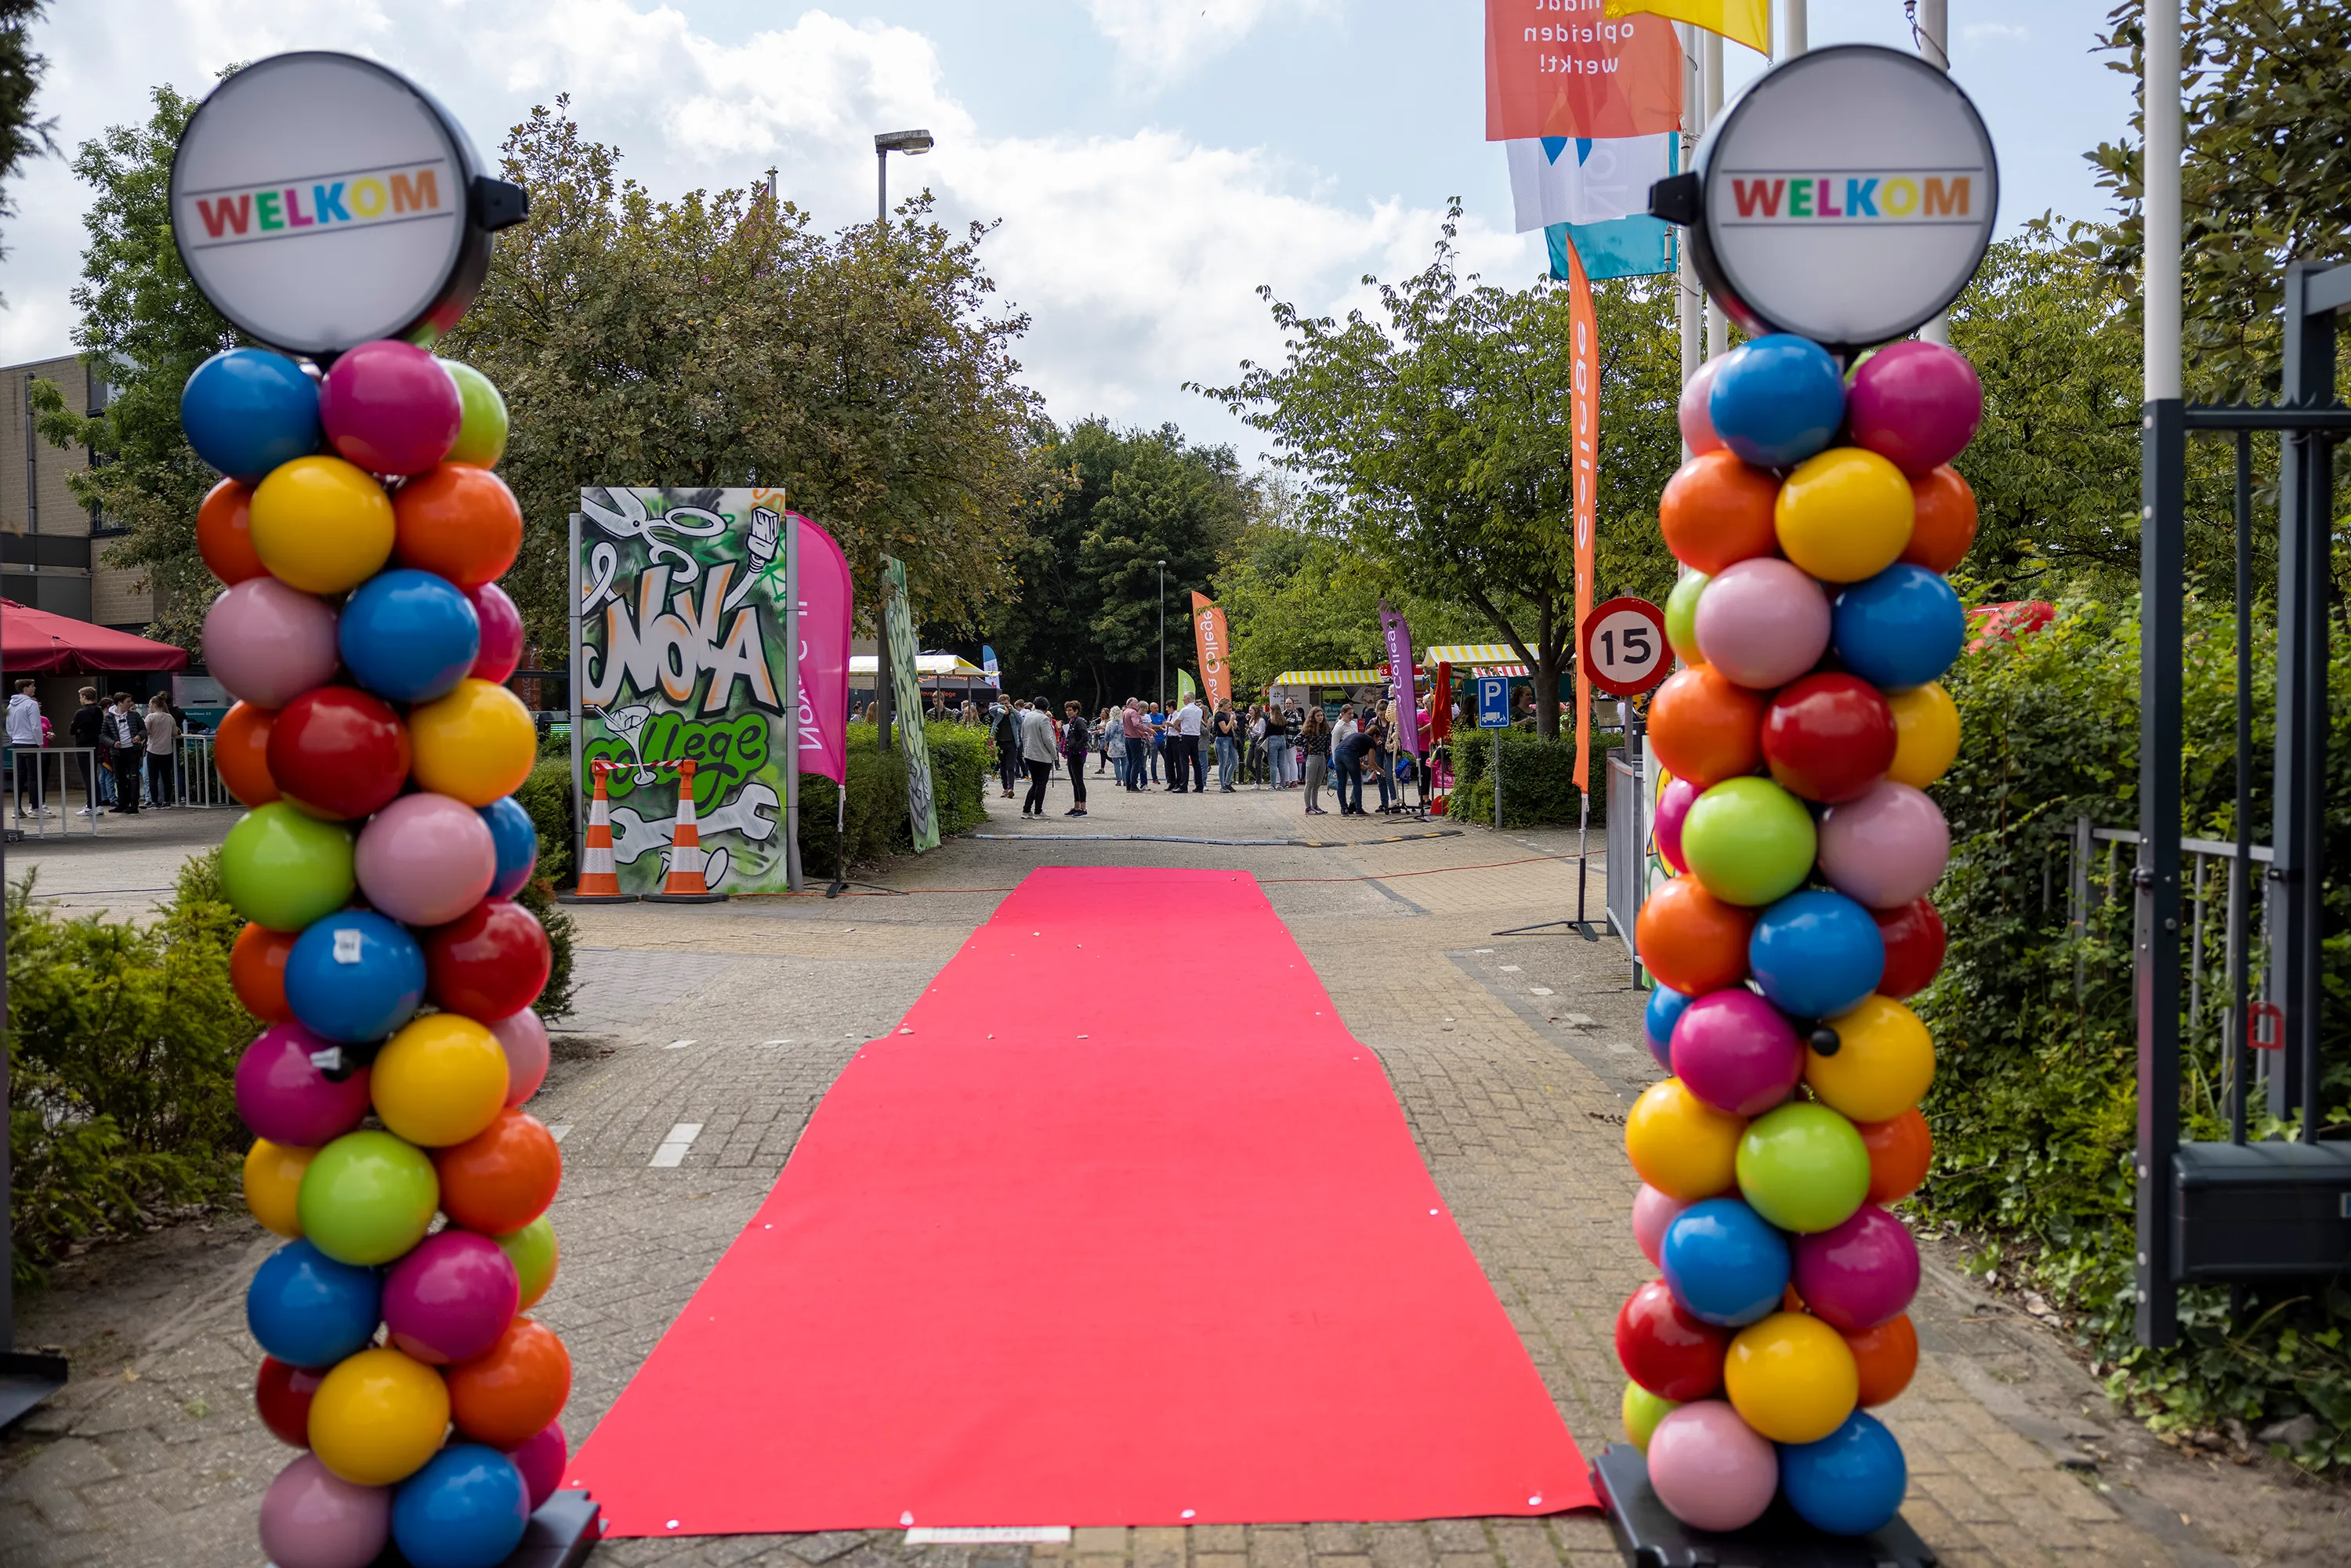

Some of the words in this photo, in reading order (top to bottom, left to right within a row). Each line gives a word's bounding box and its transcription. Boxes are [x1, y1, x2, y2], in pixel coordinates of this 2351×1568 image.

[196, 169, 439, 238] WELKOM
[1732, 176, 1970, 218] WELKOM
[582, 560, 784, 719] NOVA
[1601, 628, 1651, 665] 15
[1485, 682, 1501, 706] P
